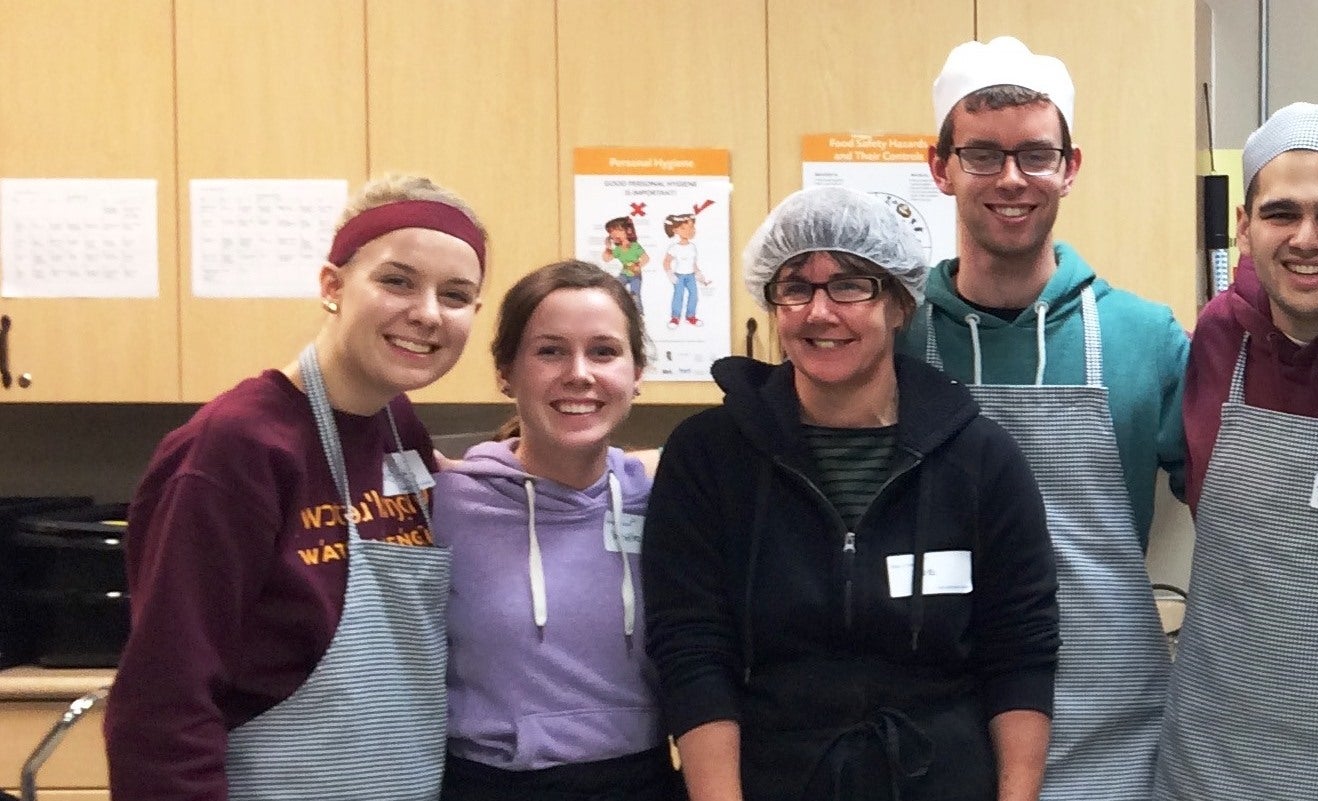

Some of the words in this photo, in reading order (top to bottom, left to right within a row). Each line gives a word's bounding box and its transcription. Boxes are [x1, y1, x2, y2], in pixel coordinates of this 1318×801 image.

[829, 138, 853, 148] Food
[855, 137, 886, 150] Safety
[888, 138, 928, 148] Hazards
[833, 151, 853, 160] and
[855, 151, 880, 160] Their
[882, 151, 925, 160] Controls
[608, 157, 654, 167] Personal
[655, 157, 695, 170] Hygiene
